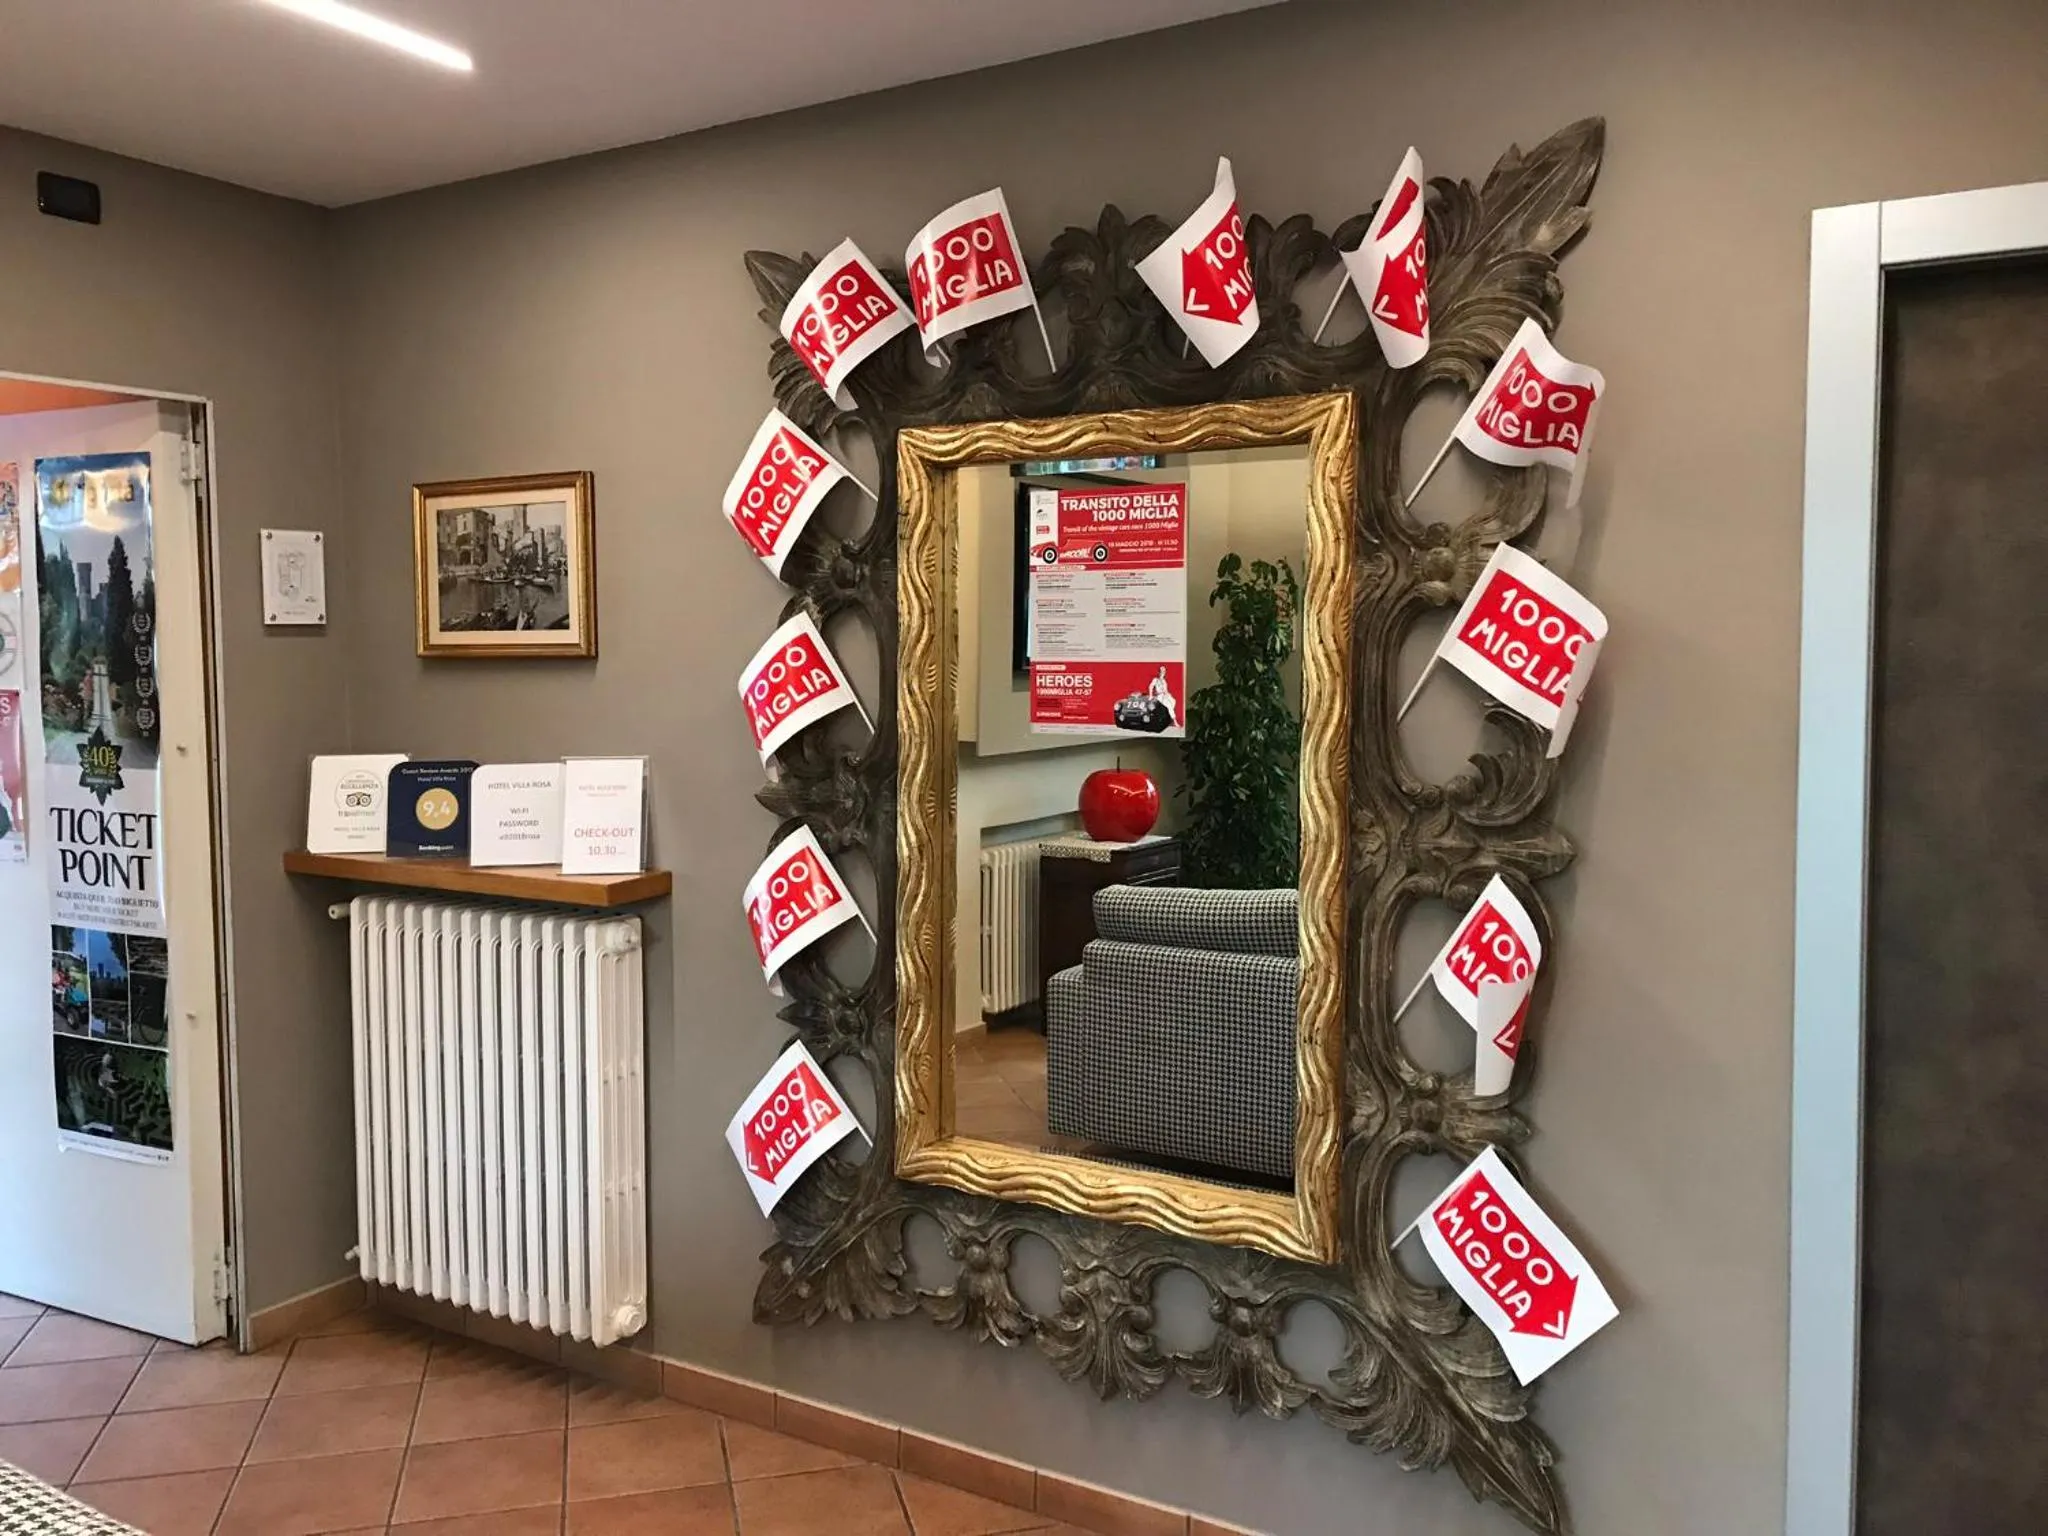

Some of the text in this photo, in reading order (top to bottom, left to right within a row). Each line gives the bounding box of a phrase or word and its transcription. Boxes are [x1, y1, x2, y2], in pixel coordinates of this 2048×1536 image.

[797, 275, 859, 347] 1000
[922, 259, 1014, 319] MIGLIA
[811, 295, 888, 377] MIGLIA
[1480, 394, 1579, 448] MIGLIA
[741, 442, 792, 520] 1000
[757, 455, 820, 545] MIGLIA
[1061, 498, 1130, 511] TRANSITO
[1133, 494, 1179, 507] DELLA
[1092, 506, 1179, 522] 1000 MIGLIA
[746, 646, 807, 709] 1000
[755, 668, 832, 735] MIGLIA
[1036, 675, 1093, 687] HEROES
[88, 746, 109, 766] 40
[49, 807, 158, 849] TICKET
[499, 820, 539, 828] PASSWORD
[574, 827, 635, 838] CHECK-OUT
[58, 848, 152, 891] POINT
[752, 860, 809, 925] 1000
[759, 882, 834, 955] MIGLIA
[754, 1077, 806, 1140] 1000
[764, 1098, 833, 1173] MIGLIA
[1439, 1207, 1533, 1319] MIGLIA
[1469, 1190, 1554, 1286] 1000
